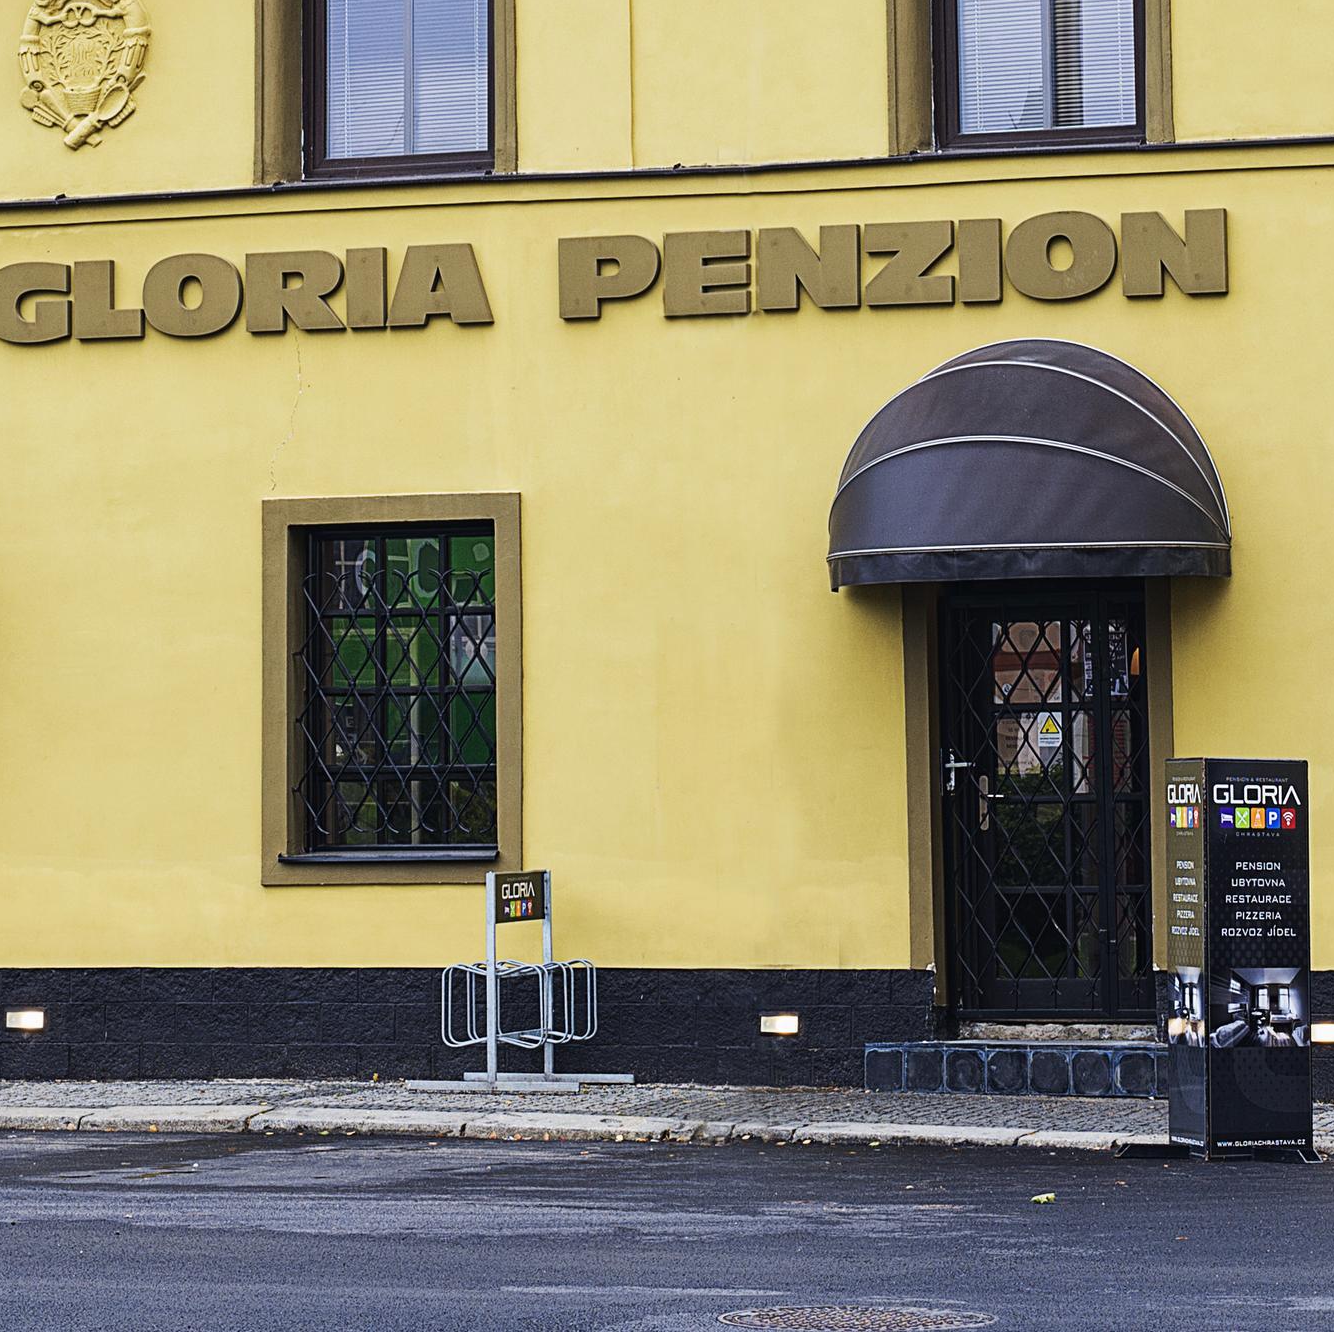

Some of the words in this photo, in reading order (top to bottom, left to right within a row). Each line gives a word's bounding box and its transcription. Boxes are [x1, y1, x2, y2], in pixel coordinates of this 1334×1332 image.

[558, 207, 1230, 322] PENZION
[1167, 783, 1202, 805] GLORIA
[1212, 784, 1302, 806] GLORIA
[1176, 860, 1195, 870] PENSION
[1235, 861, 1281, 871] PENSION
[1231, 878, 1286, 887] UBYTOVNA
[502, 882, 534, 898] GLORIA
[1225, 894, 1292, 904] RESTAURACE
[1235, 911, 1282, 920] PIZZERIA
[1221, 927, 1263, 937] ROZVOZ
[1267, 924, 1297, 937] JÍDEL
[1216, 1139, 1306, 1148] WWW.GLORIACHRASTAVA.CZ
